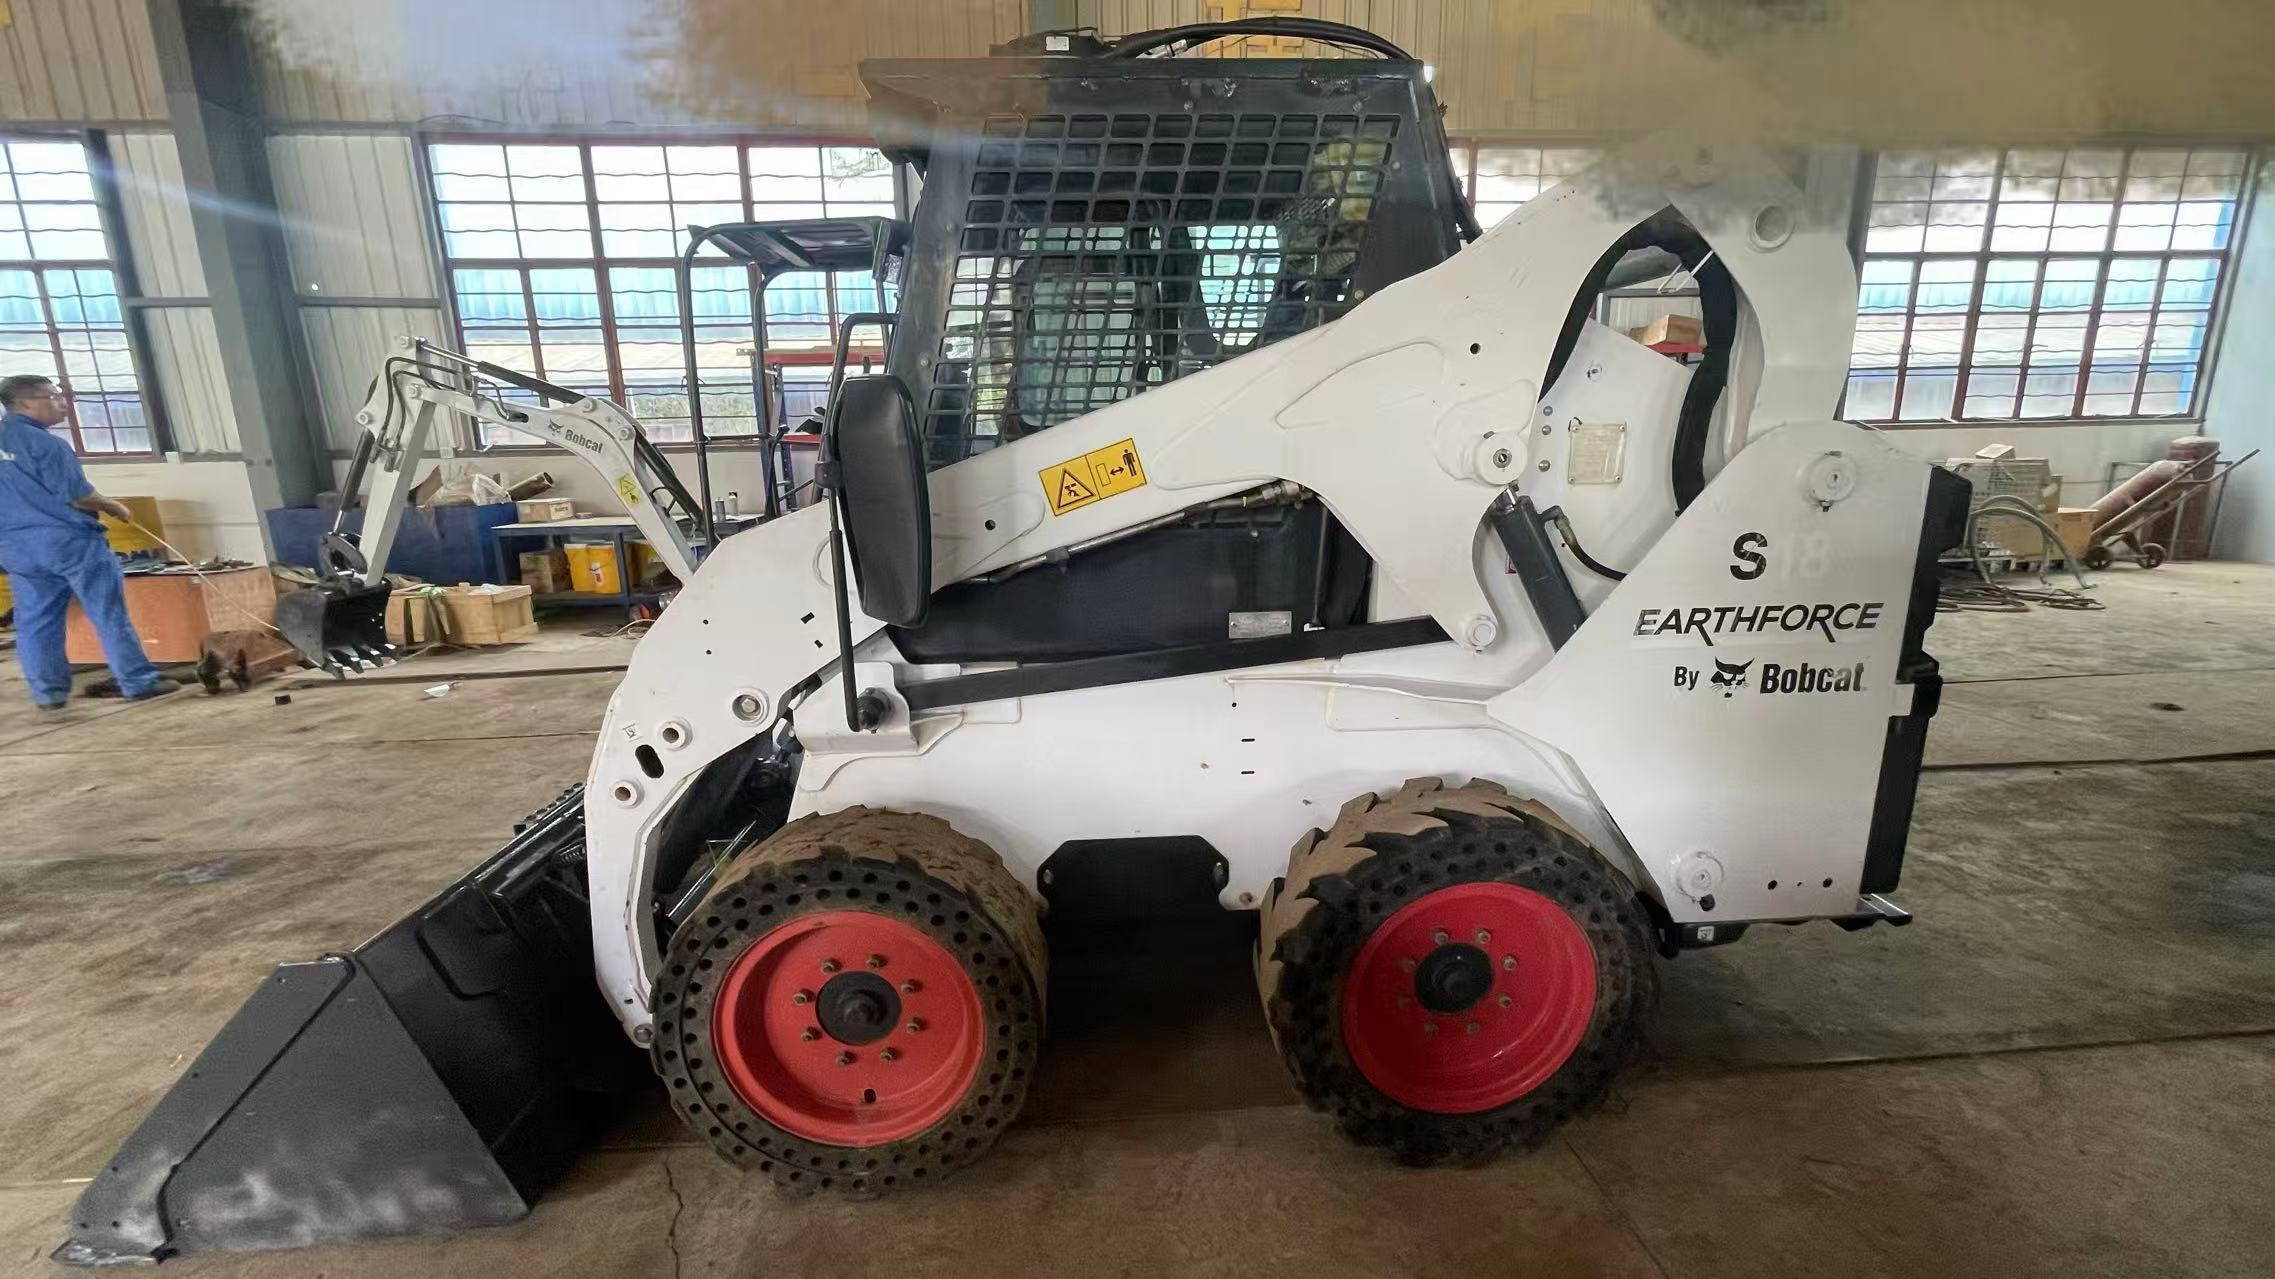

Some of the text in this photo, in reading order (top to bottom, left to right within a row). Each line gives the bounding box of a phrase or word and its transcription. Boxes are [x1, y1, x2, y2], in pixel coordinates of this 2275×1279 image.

[564, 428, 604, 454] Bobcat
[1633, 602, 1885, 647] EARTHFORCE
[1674, 662, 1865, 694] By Bobcat
